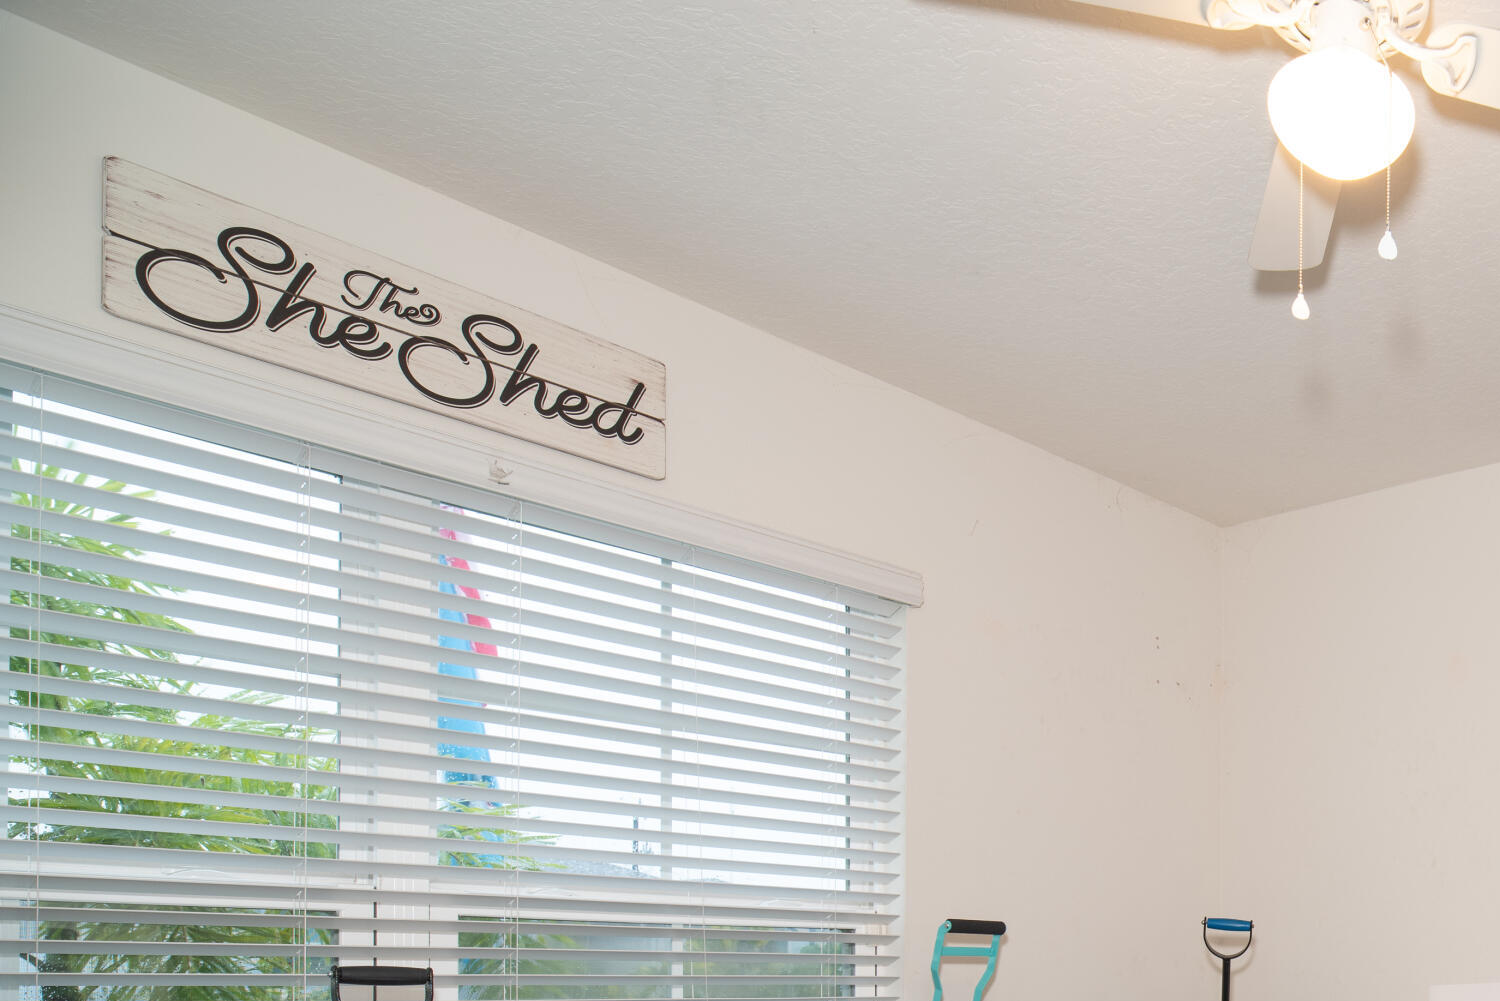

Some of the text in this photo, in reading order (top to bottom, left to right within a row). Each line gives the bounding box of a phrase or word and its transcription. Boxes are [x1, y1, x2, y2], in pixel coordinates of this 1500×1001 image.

[135, 226, 646, 446] She Shed
[341, 268, 441, 327] The
